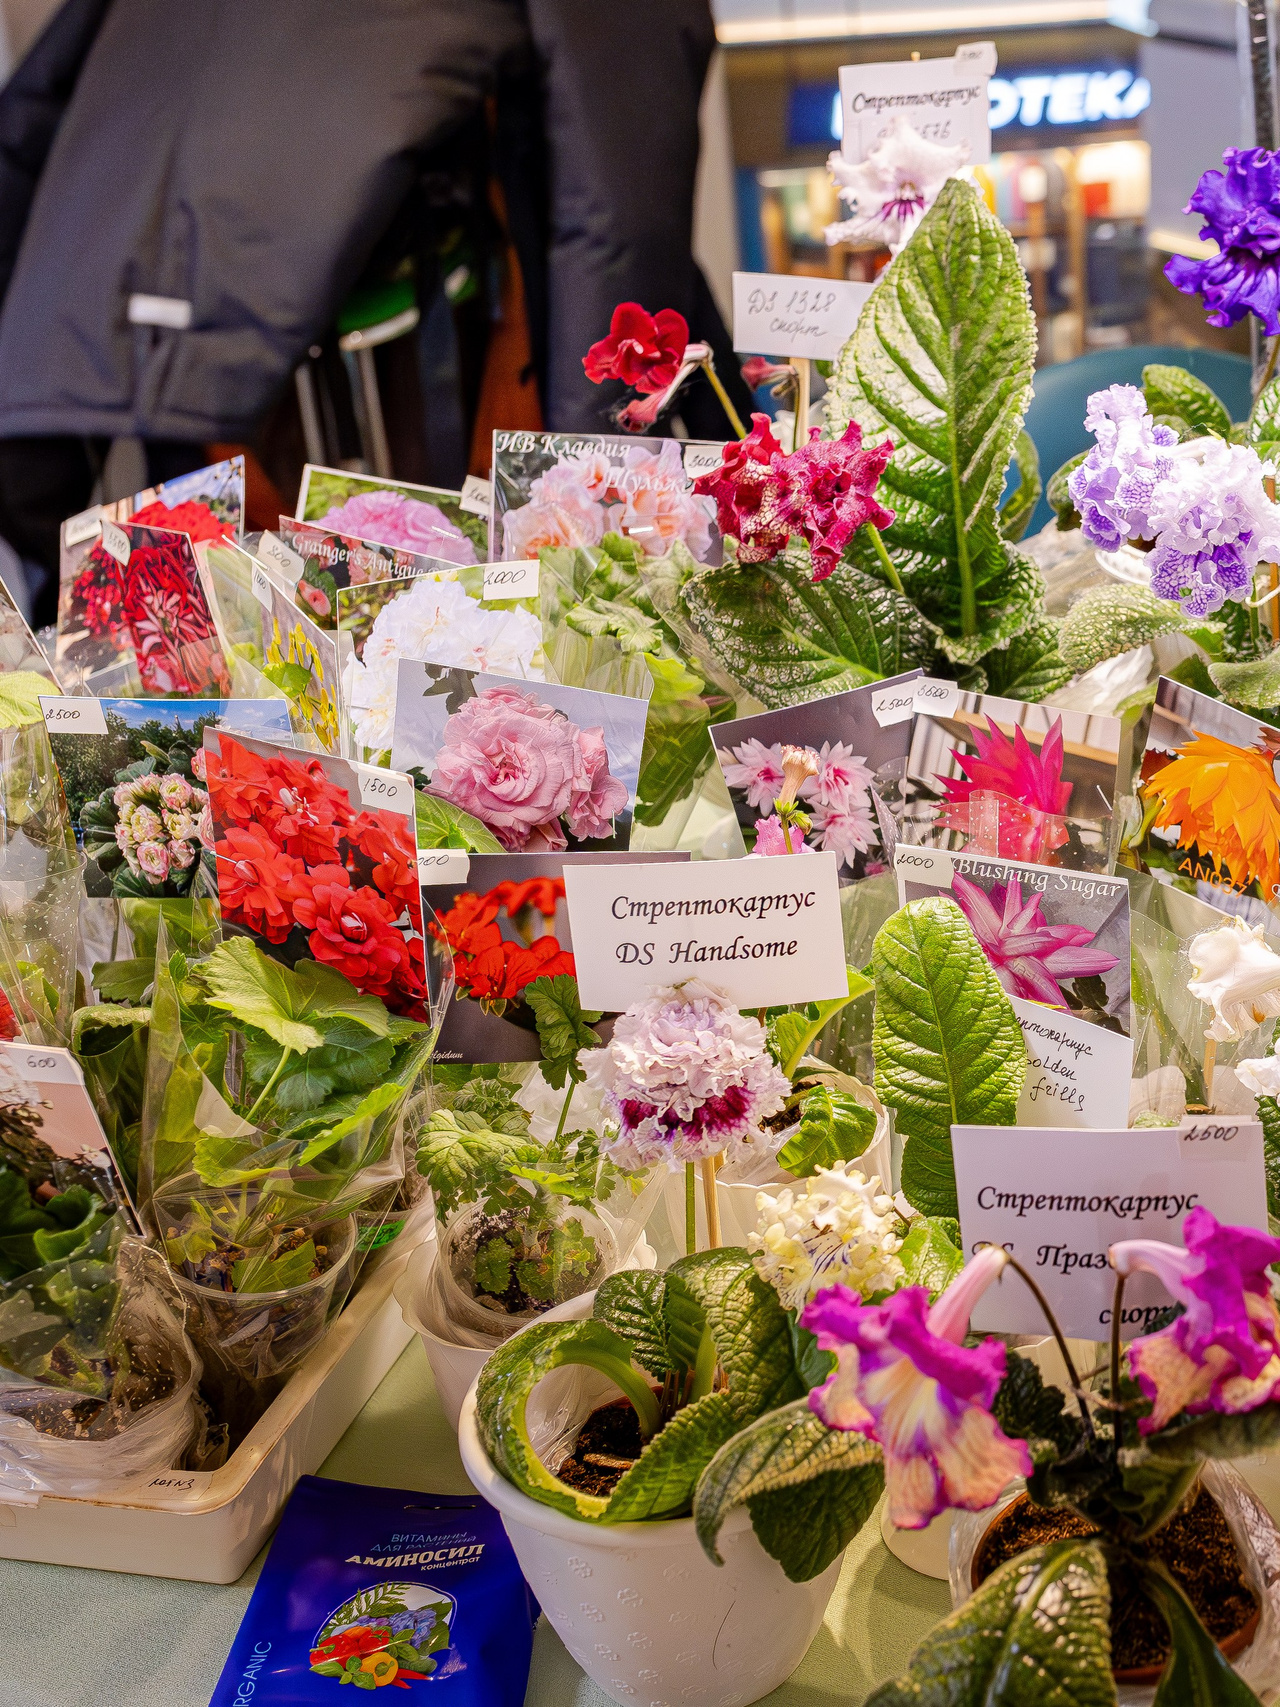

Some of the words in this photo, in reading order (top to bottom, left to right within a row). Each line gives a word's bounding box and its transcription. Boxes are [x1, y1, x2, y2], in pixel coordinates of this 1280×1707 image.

[495, 431, 536, 454] ИВ
[540, 436, 631, 458] Клавдия
[292, 533, 361, 567] Grainger's
[483, 568, 527, 586] 2000
[45, 708, 81, 720] 2500
[363, 777, 398, 797] 1500
[896, 853, 935, 869] 2000
[952, 858, 1050, 892] Blushing
[1054, 873, 1123, 900] Sugar
[1177, 857, 1248, 899] AN037
[611, 890, 816, 925] Стрептокарпус
[615, 942, 656, 966] DS
[668, 935, 798, 964] Handsome
[26, 1054, 57, 1069] 600
[1183, 1125, 1239, 1142] 2500
[977, 1185, 1199, 1220] Стрептокарпус
[1036, 1243, 1115, 1275] Праз
[344, 1543, 486, 1568] АМИНОСИЛ
[420, 1555, 481, 1572] концентрат
[232, 1641, 272, 1707] RGANIC
